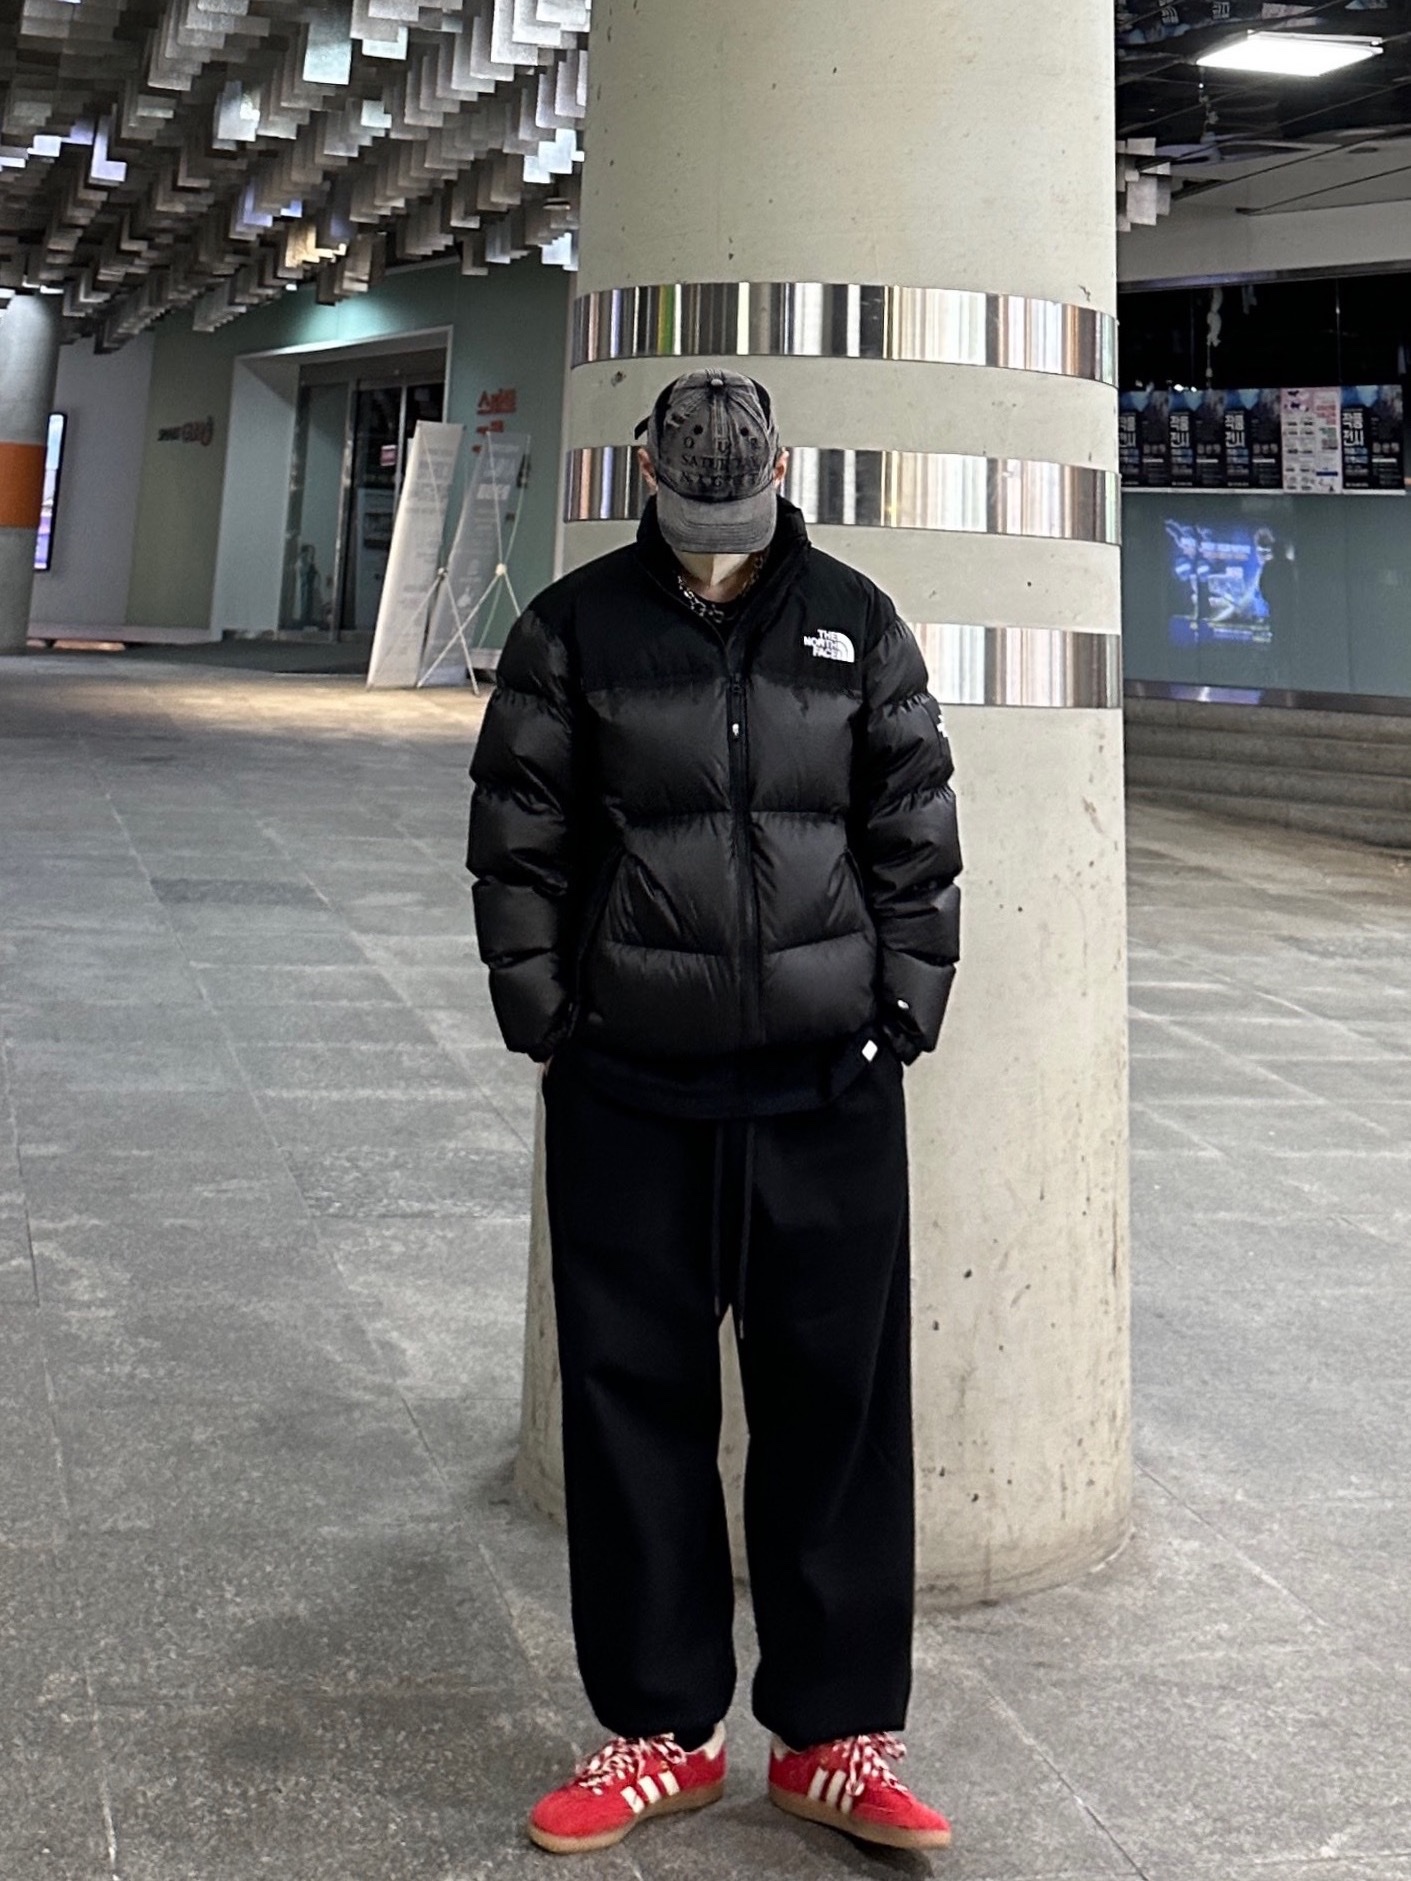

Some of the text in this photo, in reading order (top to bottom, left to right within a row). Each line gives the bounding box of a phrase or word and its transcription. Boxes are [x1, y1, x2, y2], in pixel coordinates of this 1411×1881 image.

[817, 629, 838, 641] THE
[803, 636, 838, 650] NORTH
[812, 646, 838, 660] FACE
